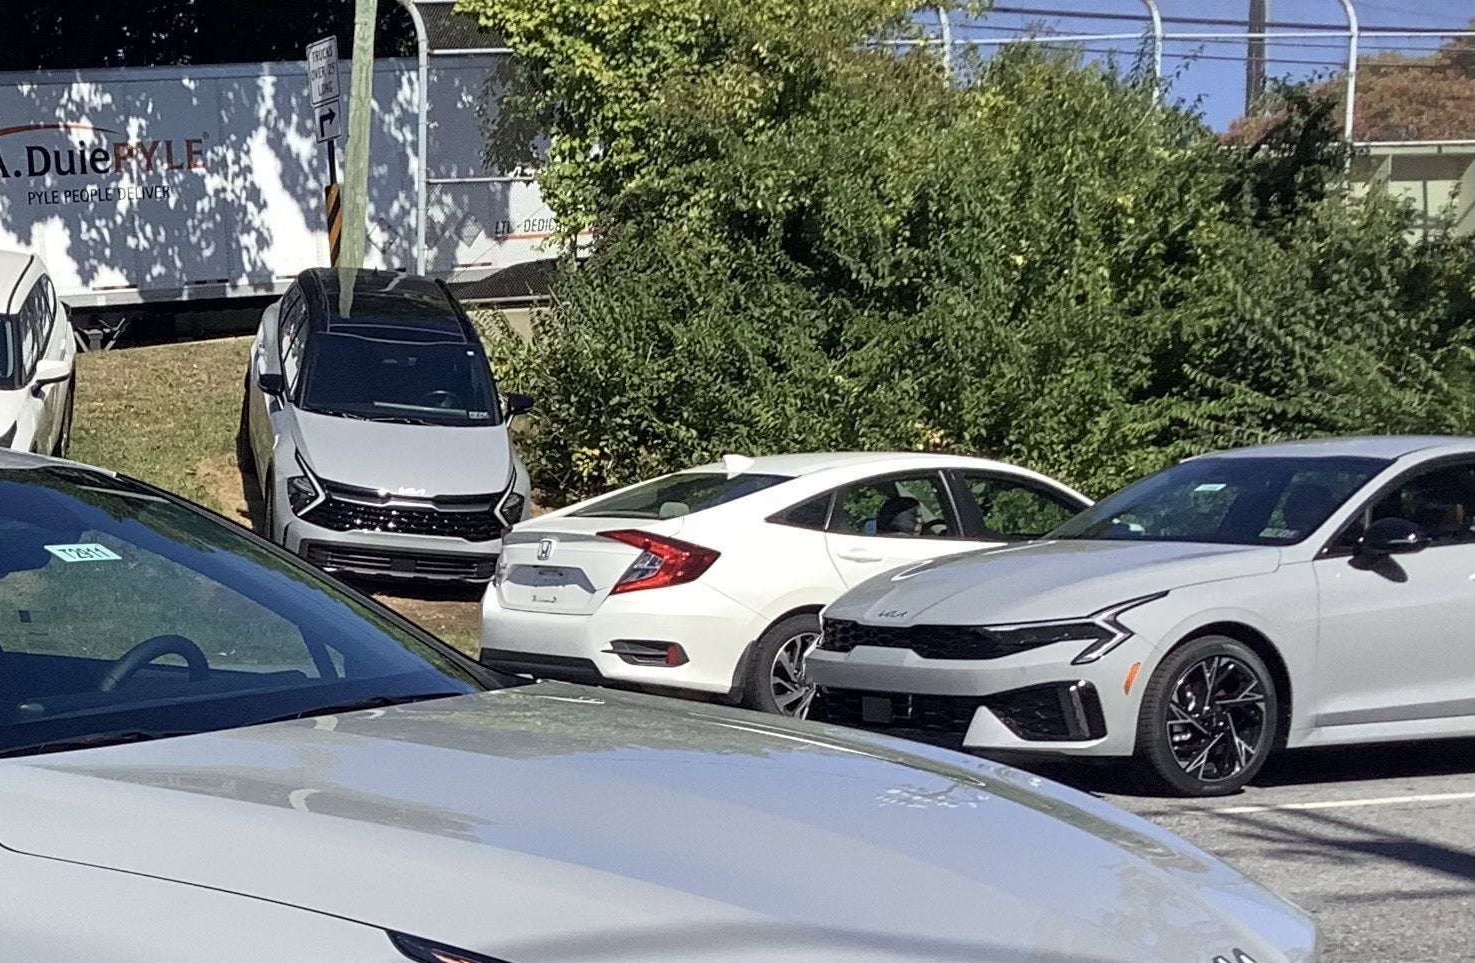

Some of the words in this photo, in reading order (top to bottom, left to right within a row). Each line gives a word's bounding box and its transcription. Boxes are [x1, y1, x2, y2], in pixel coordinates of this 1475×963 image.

[27, 190, 59, 205] PYLE
[64, 187, 113, 204] PEOPLE
[118, 185, 171, 200] DELIVER
